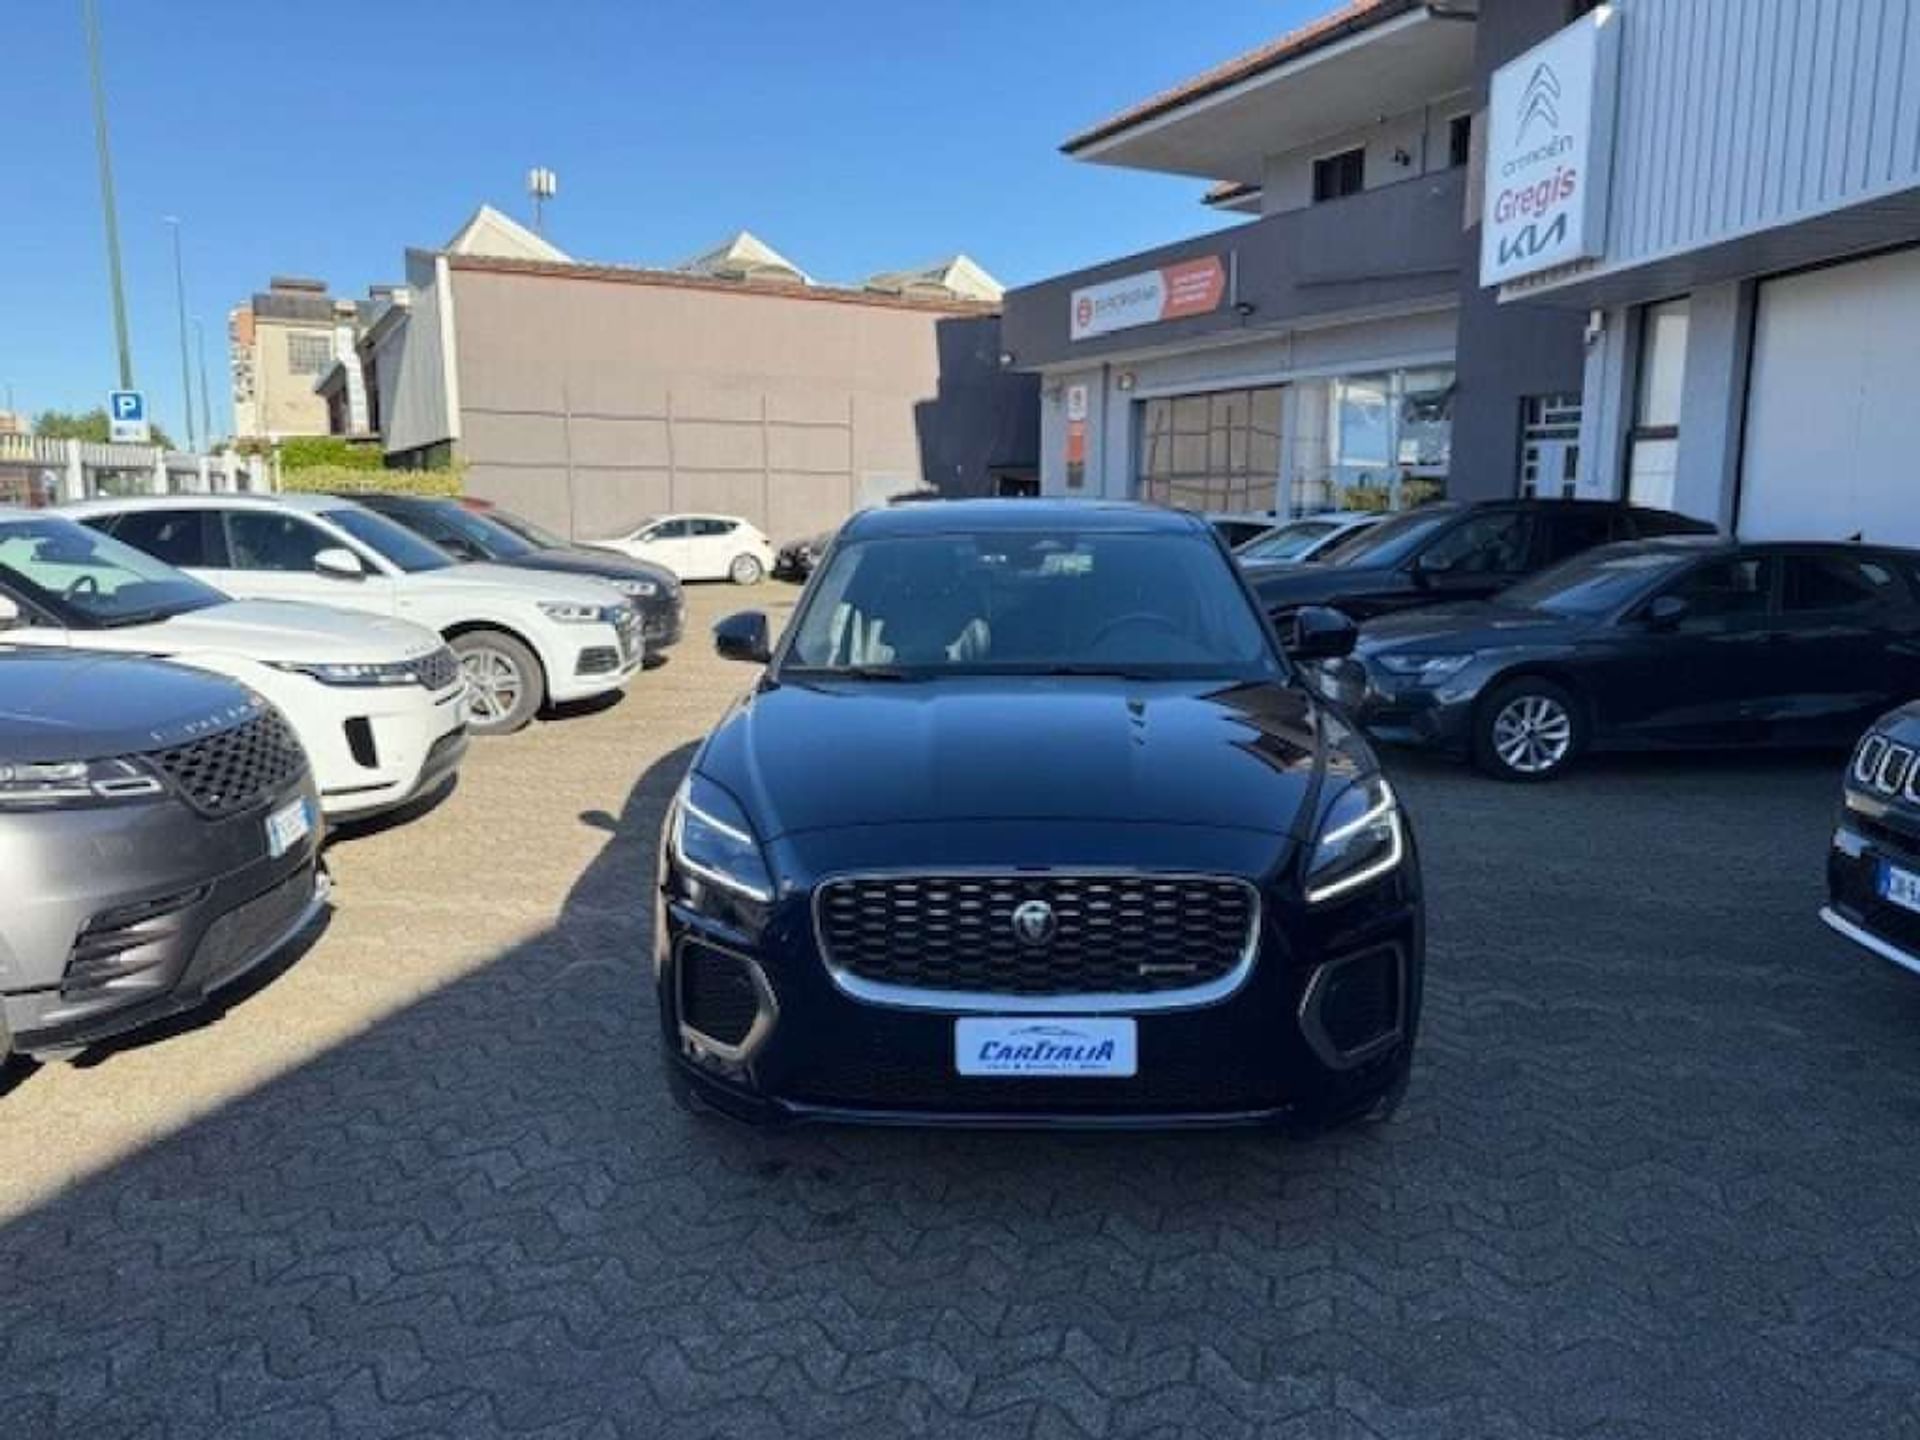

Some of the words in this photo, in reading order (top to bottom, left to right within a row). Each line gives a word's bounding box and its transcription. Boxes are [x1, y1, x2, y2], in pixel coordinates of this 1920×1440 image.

[1494, 165, 1576, 223] Gregis
[1498, 212, 1567, 265] KIA
[119, 396, 136, 418] P
